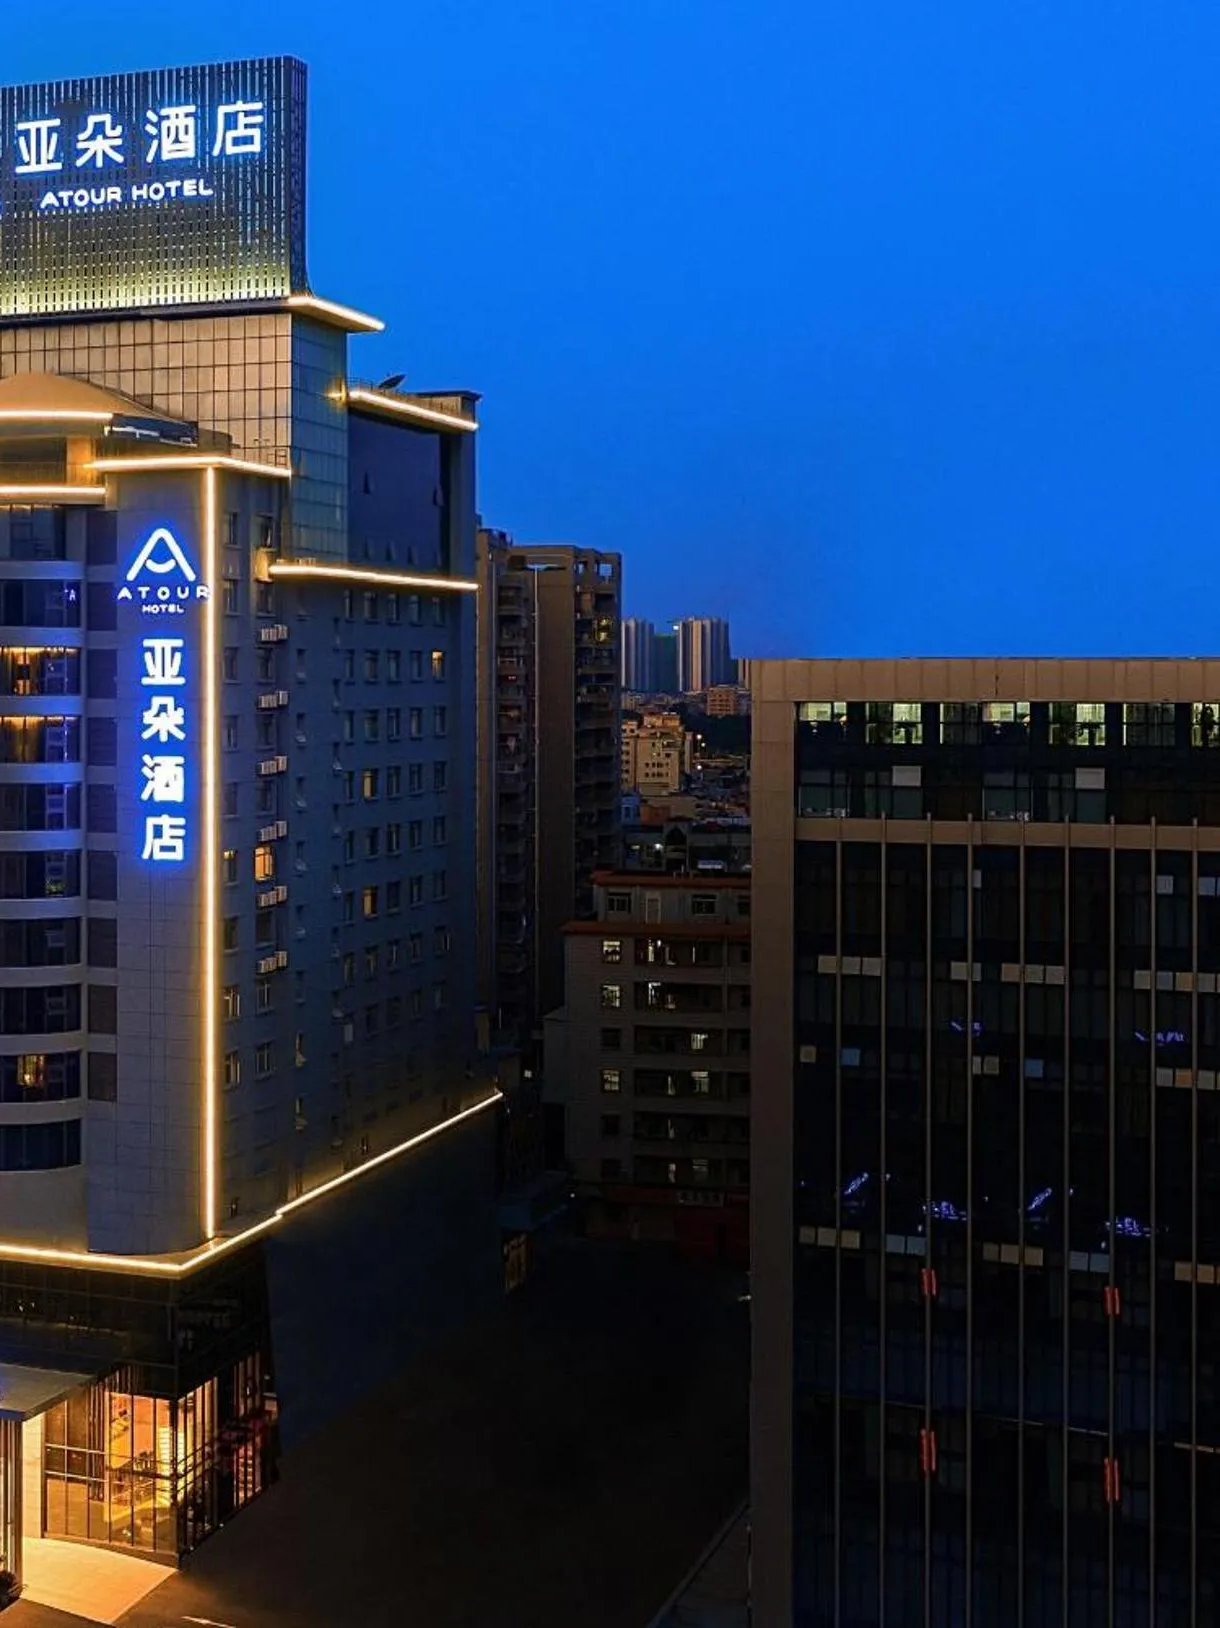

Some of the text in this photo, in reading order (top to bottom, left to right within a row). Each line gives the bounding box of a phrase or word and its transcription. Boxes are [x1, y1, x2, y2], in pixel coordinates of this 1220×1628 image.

[15, 101, 264, 174] 亚朵酒店
[40, 179, 214, 209] ATOUR HOTEL
[117, 585, 210, 601] ATOUR
[141, 603, 185, 614] HOTEL
[141, 638, 186, 861] 亚朵酒店
